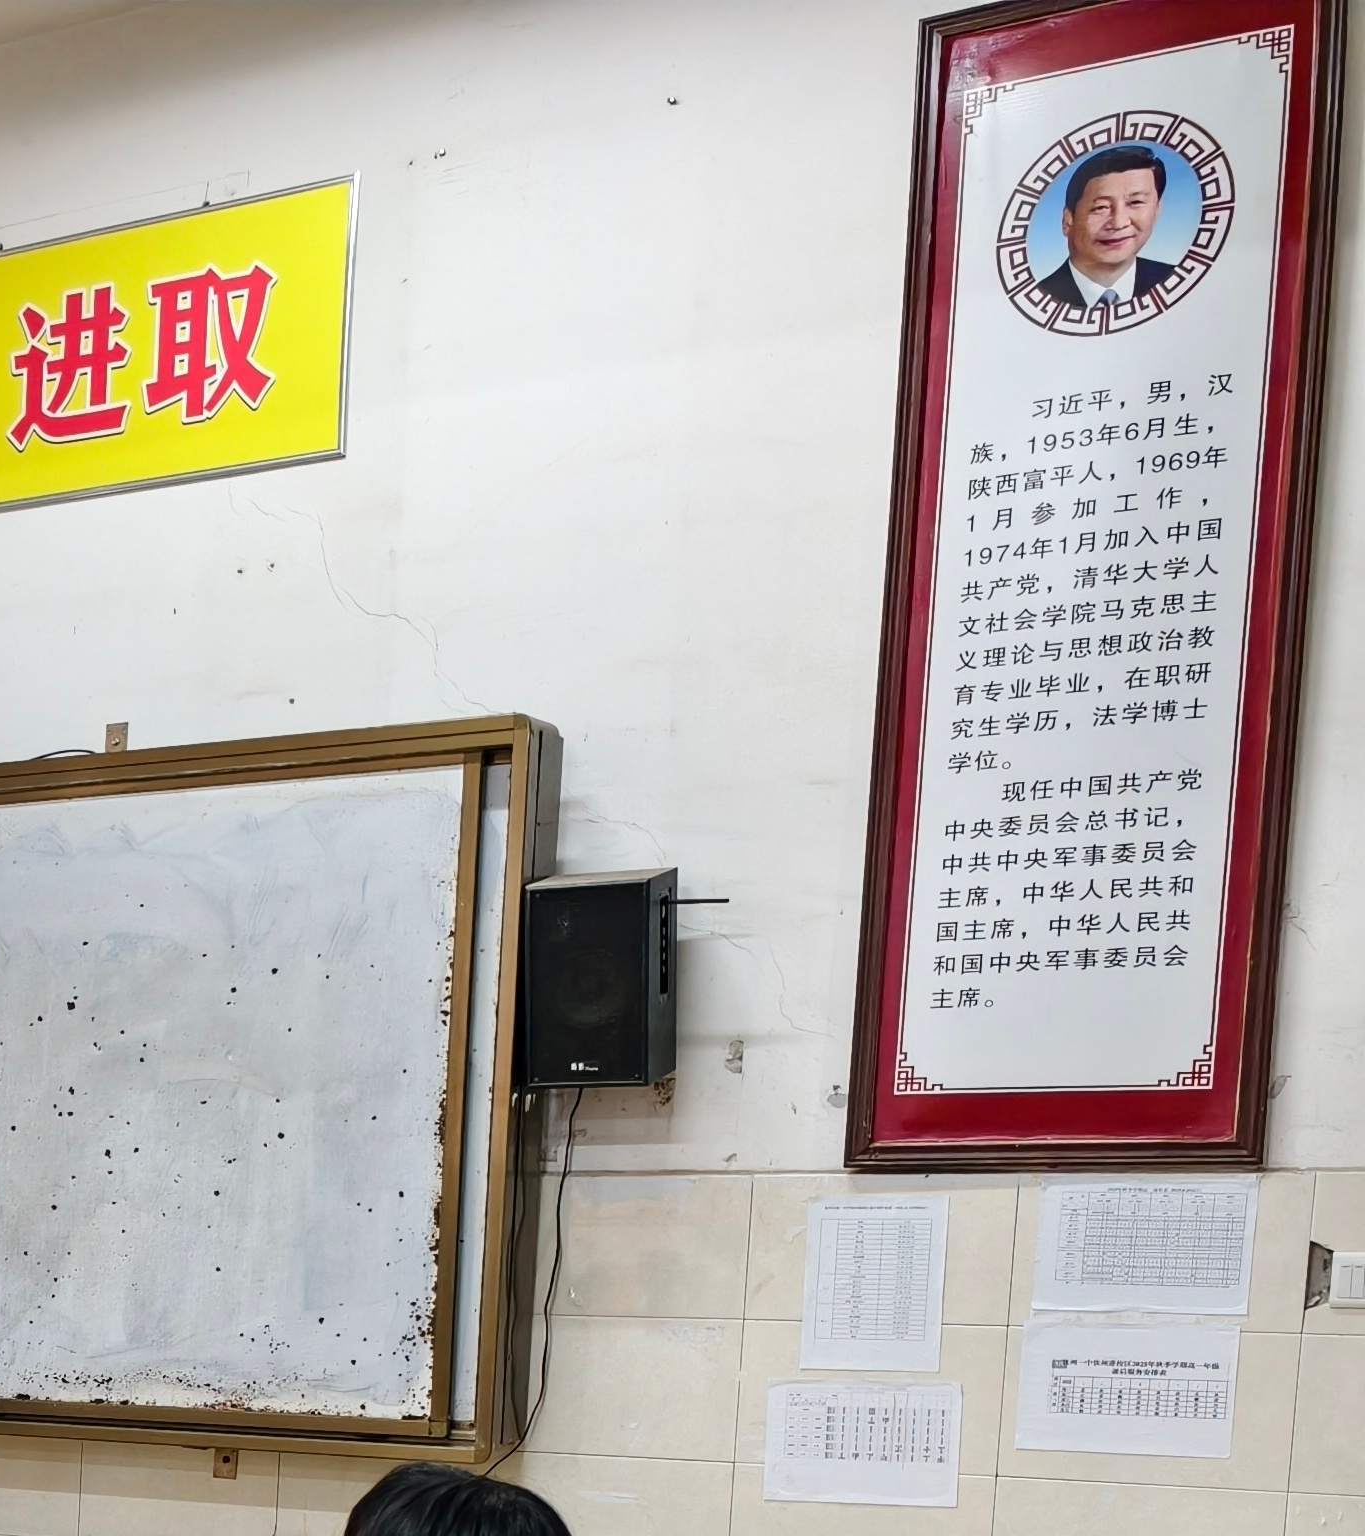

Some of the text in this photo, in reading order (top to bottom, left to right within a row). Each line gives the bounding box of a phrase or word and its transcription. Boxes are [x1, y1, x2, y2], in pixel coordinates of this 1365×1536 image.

[11, 265, 275, 450] 进取
[1032, 373, 1233, 419] 习近平，男，汉
[970, 413, 1213, 464] 族，1953年6月生，
[968, 446, 1229, 500] 陕西富平人，1969年
[967, 486, 1208, 532] 1月参加工作，
[965, 517, 1222, 567] 1974年1月加入中国
[961, 554, 1219, 603] 共产党，清华大学人
[958, 590, 1217, 637] 文社会学院马克思主
[956, 625, 1215, 672] 义理论与思想政治教
[954, 662, 1211, 706] 育专业毕业，在职研
[951, 697, 1208, 740] 究生学历，法学博士
[948, 750, 1011, 774] 学位。
[1001, 768, 1202, 802] 现任中国共产党
[945, 807, 1182, 841] 中央委员会总书记，
[943, 839, 1197, 875] 中共中央军事委员会
[938, 874, 1194, 909] 主席，中华人民共和
[937, 909, 1191, 942] 国主席，中华人民共
[933, 944, 1188, 975] 和国中央军事委员会
[930, 987, 993, 1009] 主席。
